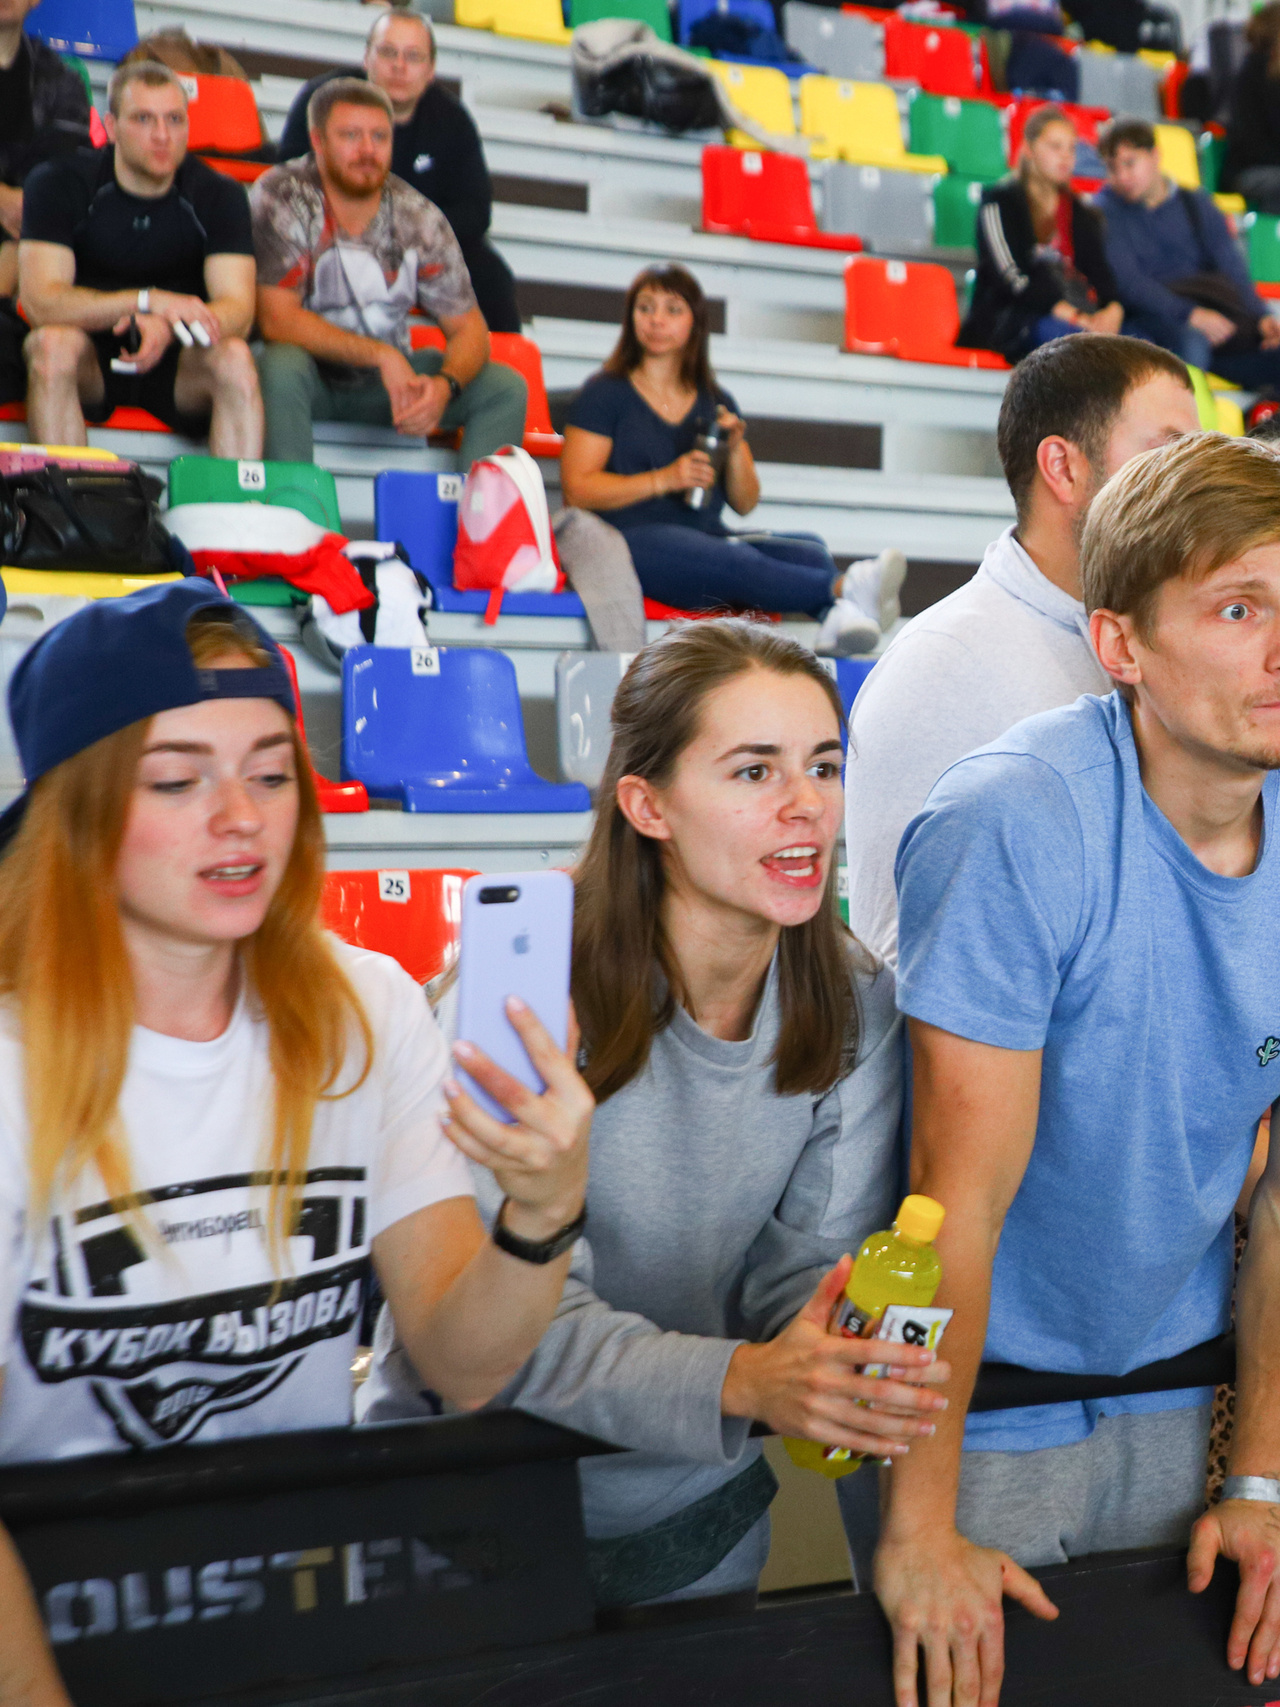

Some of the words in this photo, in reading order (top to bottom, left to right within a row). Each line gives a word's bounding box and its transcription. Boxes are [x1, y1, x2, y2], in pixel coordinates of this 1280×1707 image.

[242, 469, 260, 482] 26
[415, 651, 433, 667] 26
[384, 877, 404, 896] 25
[37, 1317, 205, 1370] КУБОК
[203, 1278, 362, 1356] ВЫЗОВА
